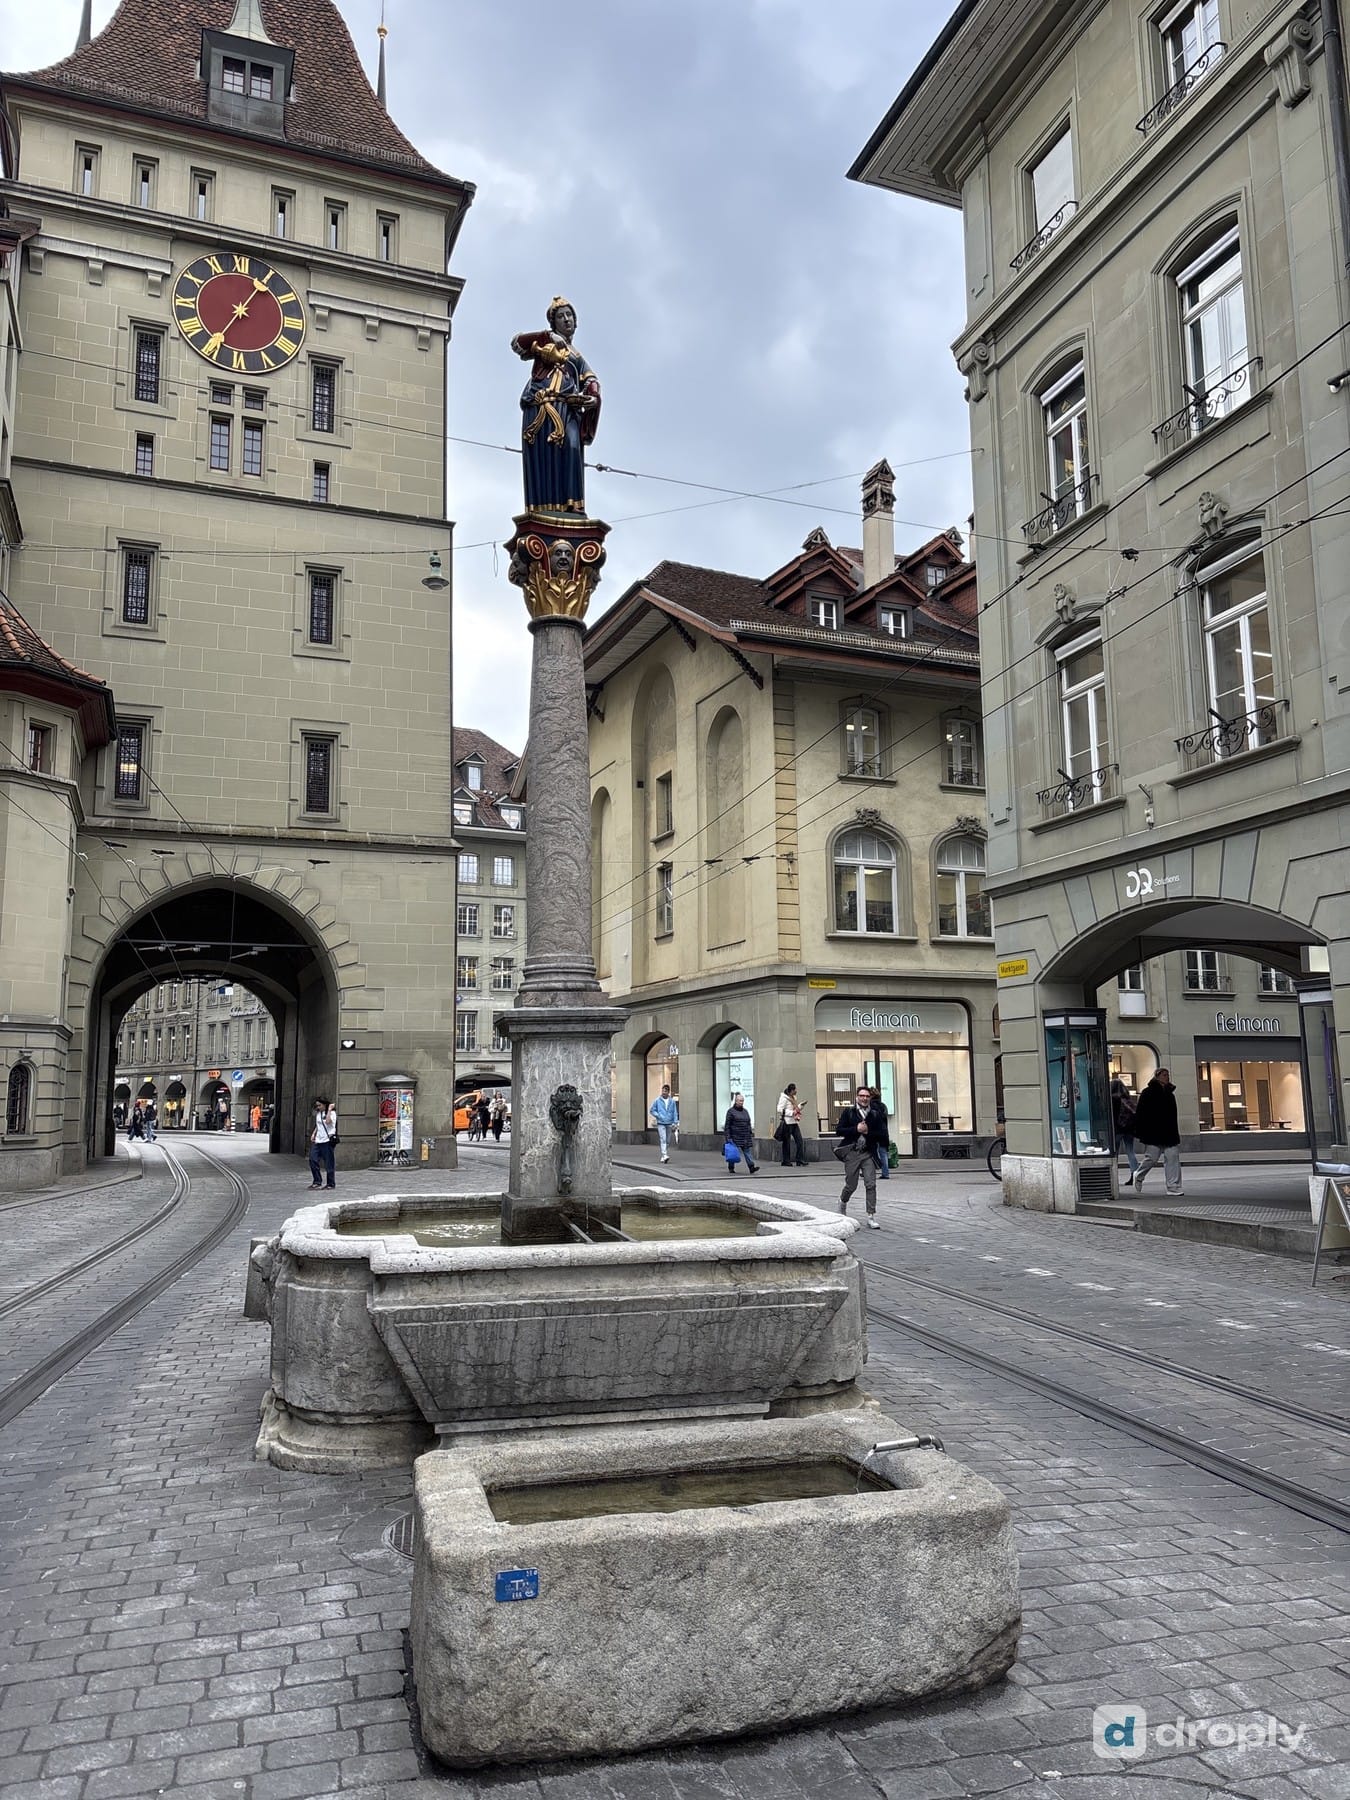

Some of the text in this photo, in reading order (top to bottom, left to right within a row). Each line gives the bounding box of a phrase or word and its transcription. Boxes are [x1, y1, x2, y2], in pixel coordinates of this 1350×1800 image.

[204, 256, 224, 275] XI
[233, 255, 249, 274] XII
[183, 270, 204, 288] X
[262, 269, 275, 284] I
[175, 294, 196, 309] IX
[278, 292, 296, 304] II
[179, 317, 203, 339] VIII
[284, 317, 303, 330] III
[274, 335, 297, 356] IIII
[232, 351, 246, 370] VI
[261, 351, 275, 369] V
[850, 1007, 921, 1029] fielmann
[1215, 1012, 1281, 1032] fielmann
